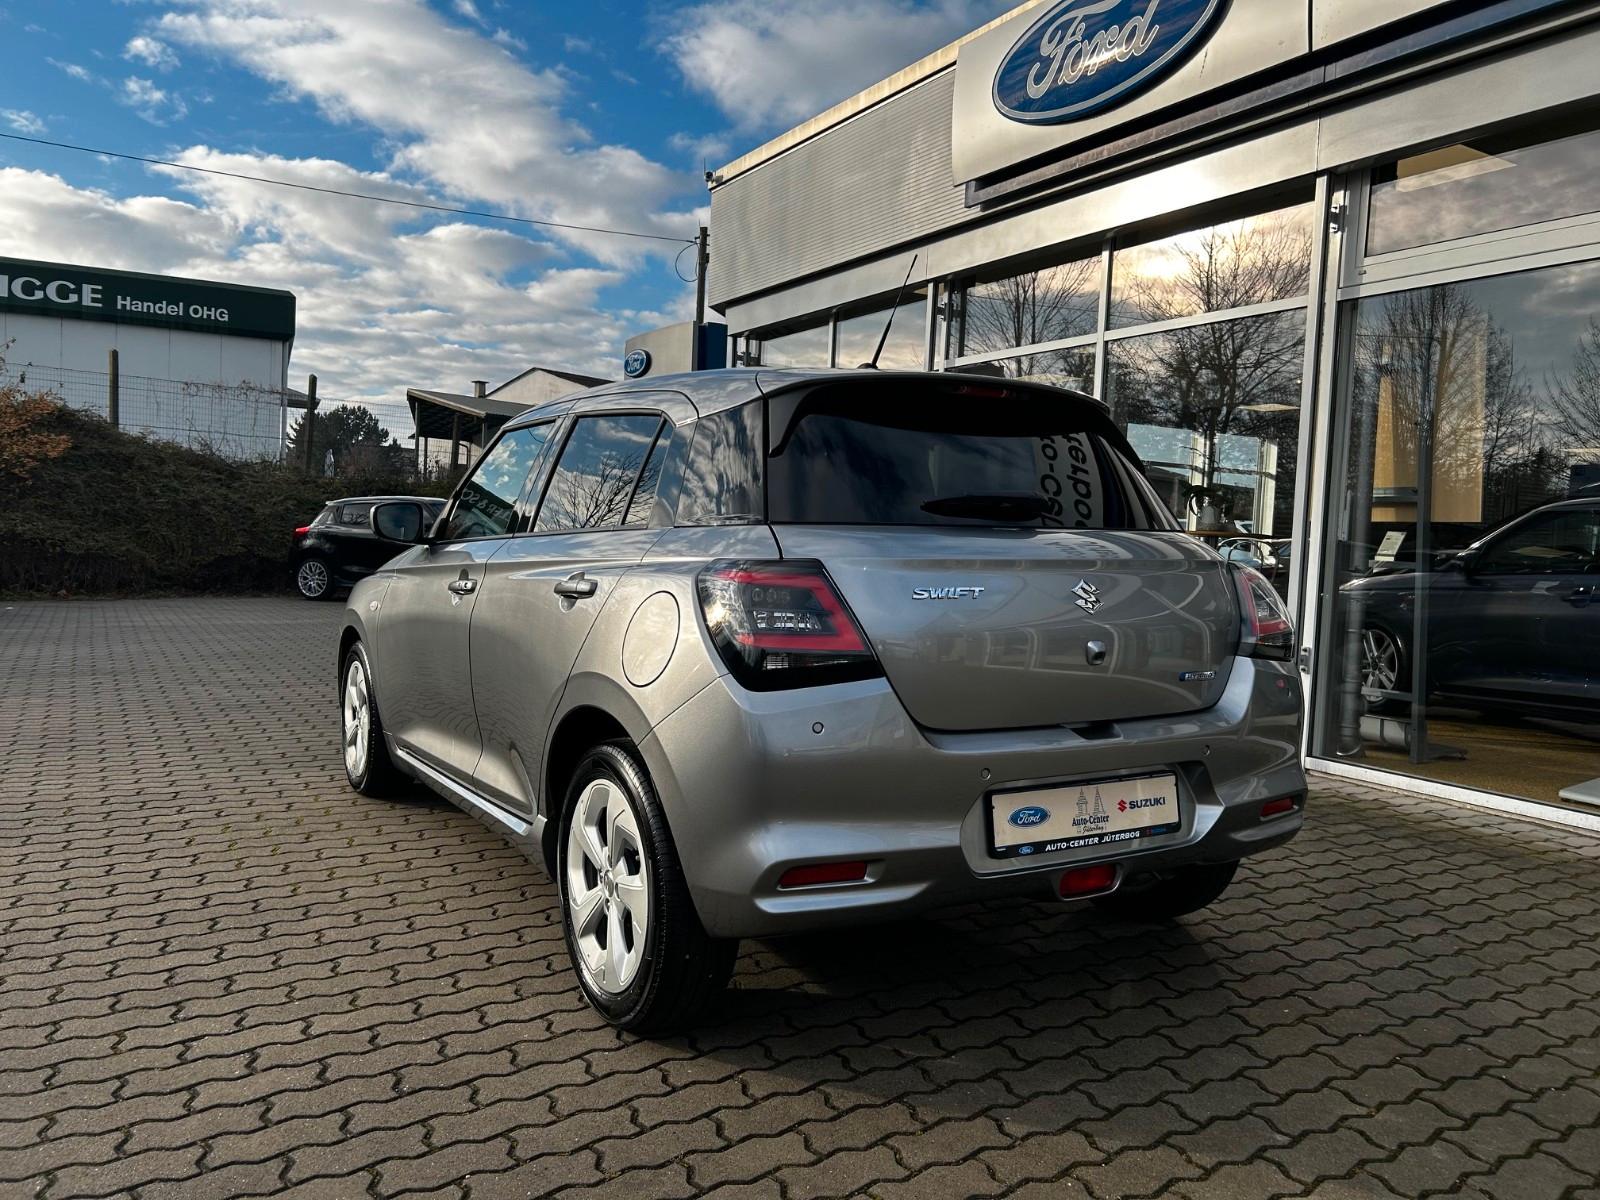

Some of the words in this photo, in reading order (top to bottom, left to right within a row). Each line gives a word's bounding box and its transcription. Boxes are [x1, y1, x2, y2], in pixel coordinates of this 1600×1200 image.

[1027, 0, 1160, 99] Ford
[116, 295, 184, 317] Handel
[188, 304, 230, 323] OHG
[626, 353, 643, 372] Ford
[912, 586, 985, 600] SWIFT
[1128, 796, 1167, 811] SUZUKI
[1016, 810, 1042, 826] Ford
[1071, 814, 1110, 827] Auto-Center
[1045, 836, 1099, 852] AUTO-CENTER
[1101, 830, 1141, 844] JÜTERBOG
